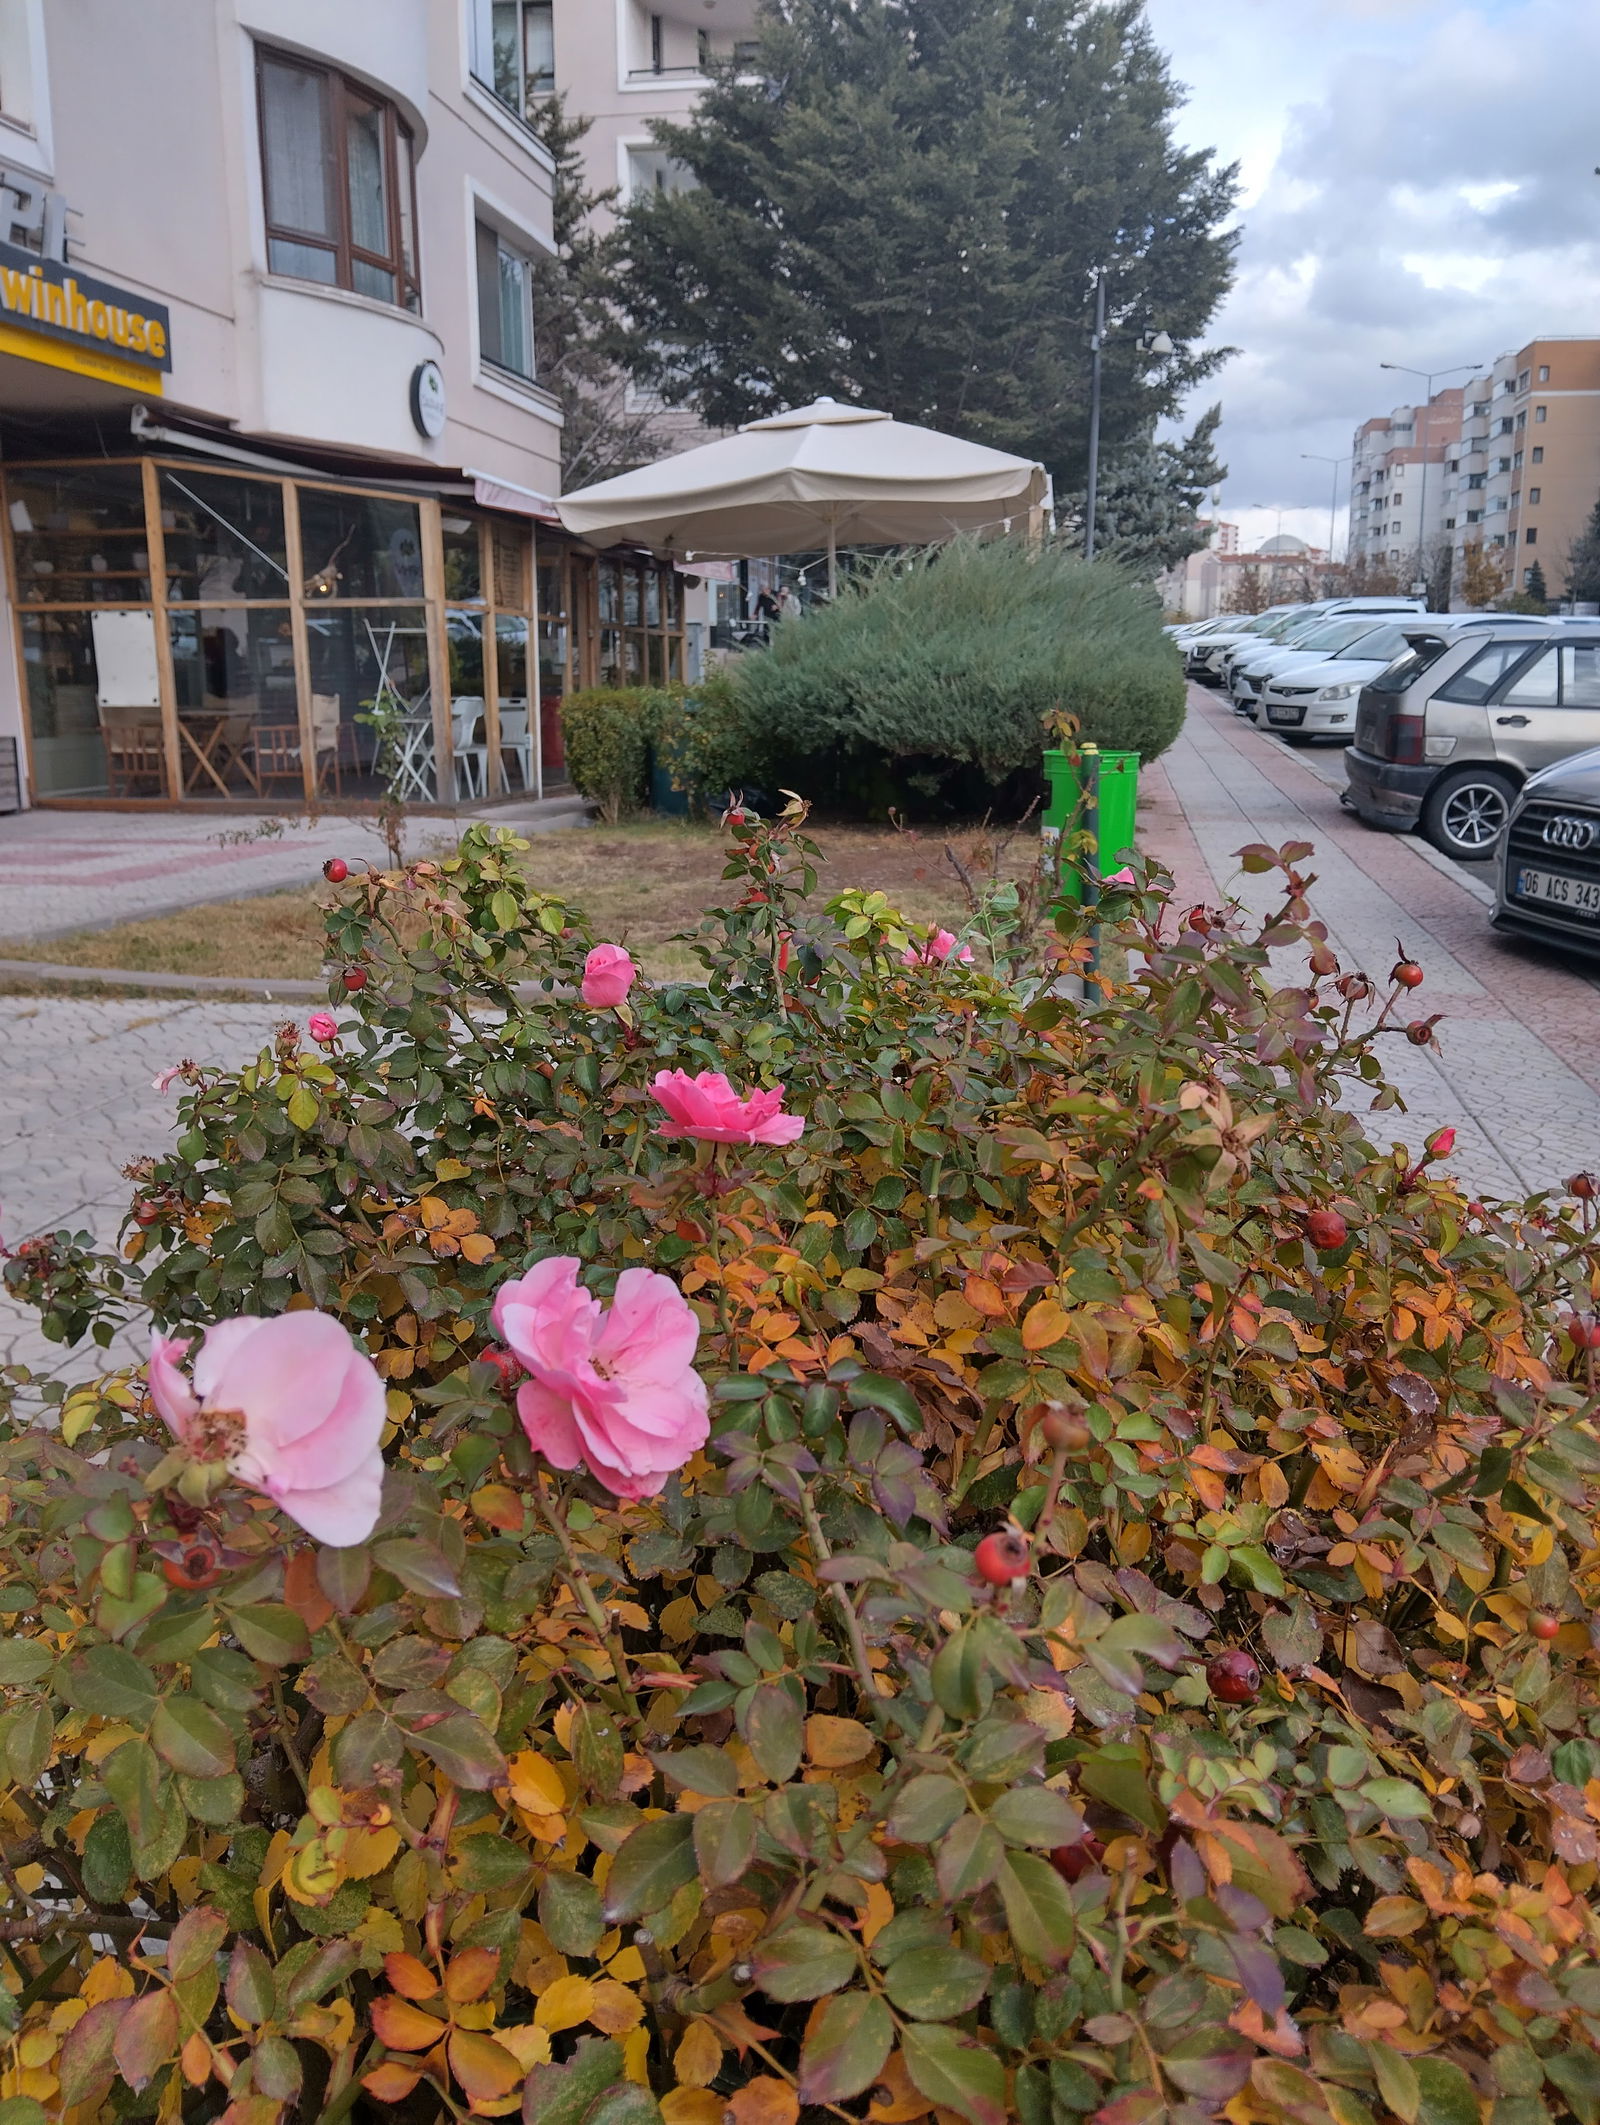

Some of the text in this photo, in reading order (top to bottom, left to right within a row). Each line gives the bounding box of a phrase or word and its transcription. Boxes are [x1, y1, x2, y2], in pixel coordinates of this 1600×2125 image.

[0, 265, 166, 358] winhouse
[1525, 872, 1600, 908] 06 ACS 343
